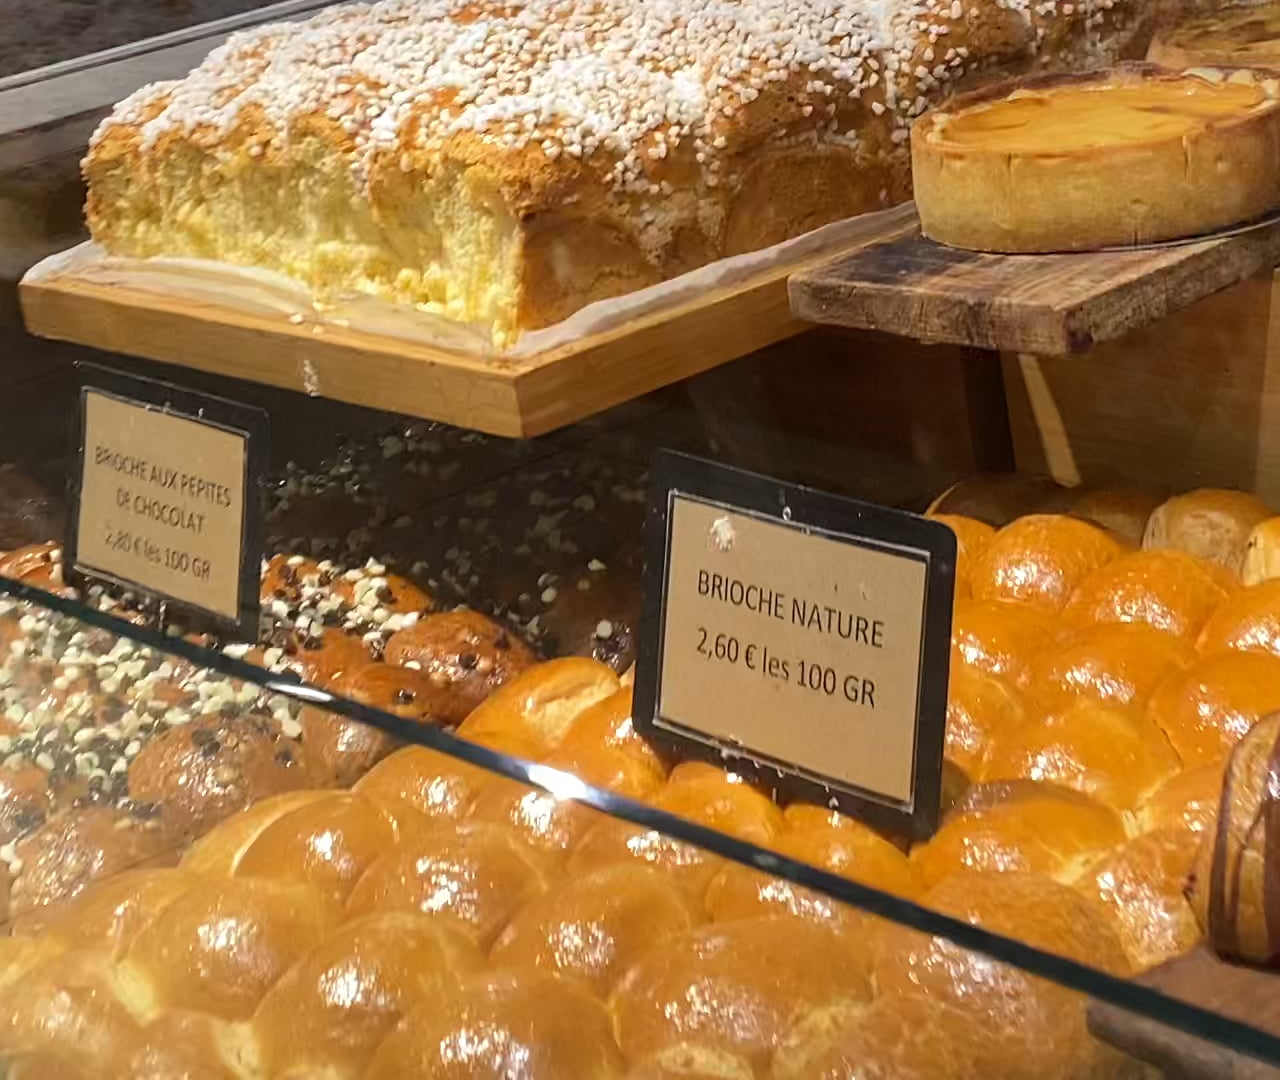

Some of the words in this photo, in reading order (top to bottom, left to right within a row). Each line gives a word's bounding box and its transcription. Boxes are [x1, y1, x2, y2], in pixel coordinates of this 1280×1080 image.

[698, 570, 784, 619] BRIOCHE
[792, 598, 883, 648] NATURE
[697, 627, 739, 663] 2,60
[745, 644, 757, 670] €
[763, 647, 789, 680] les
[798, 661, 836, 695] 100
[844, 676, 874, 708] GR
